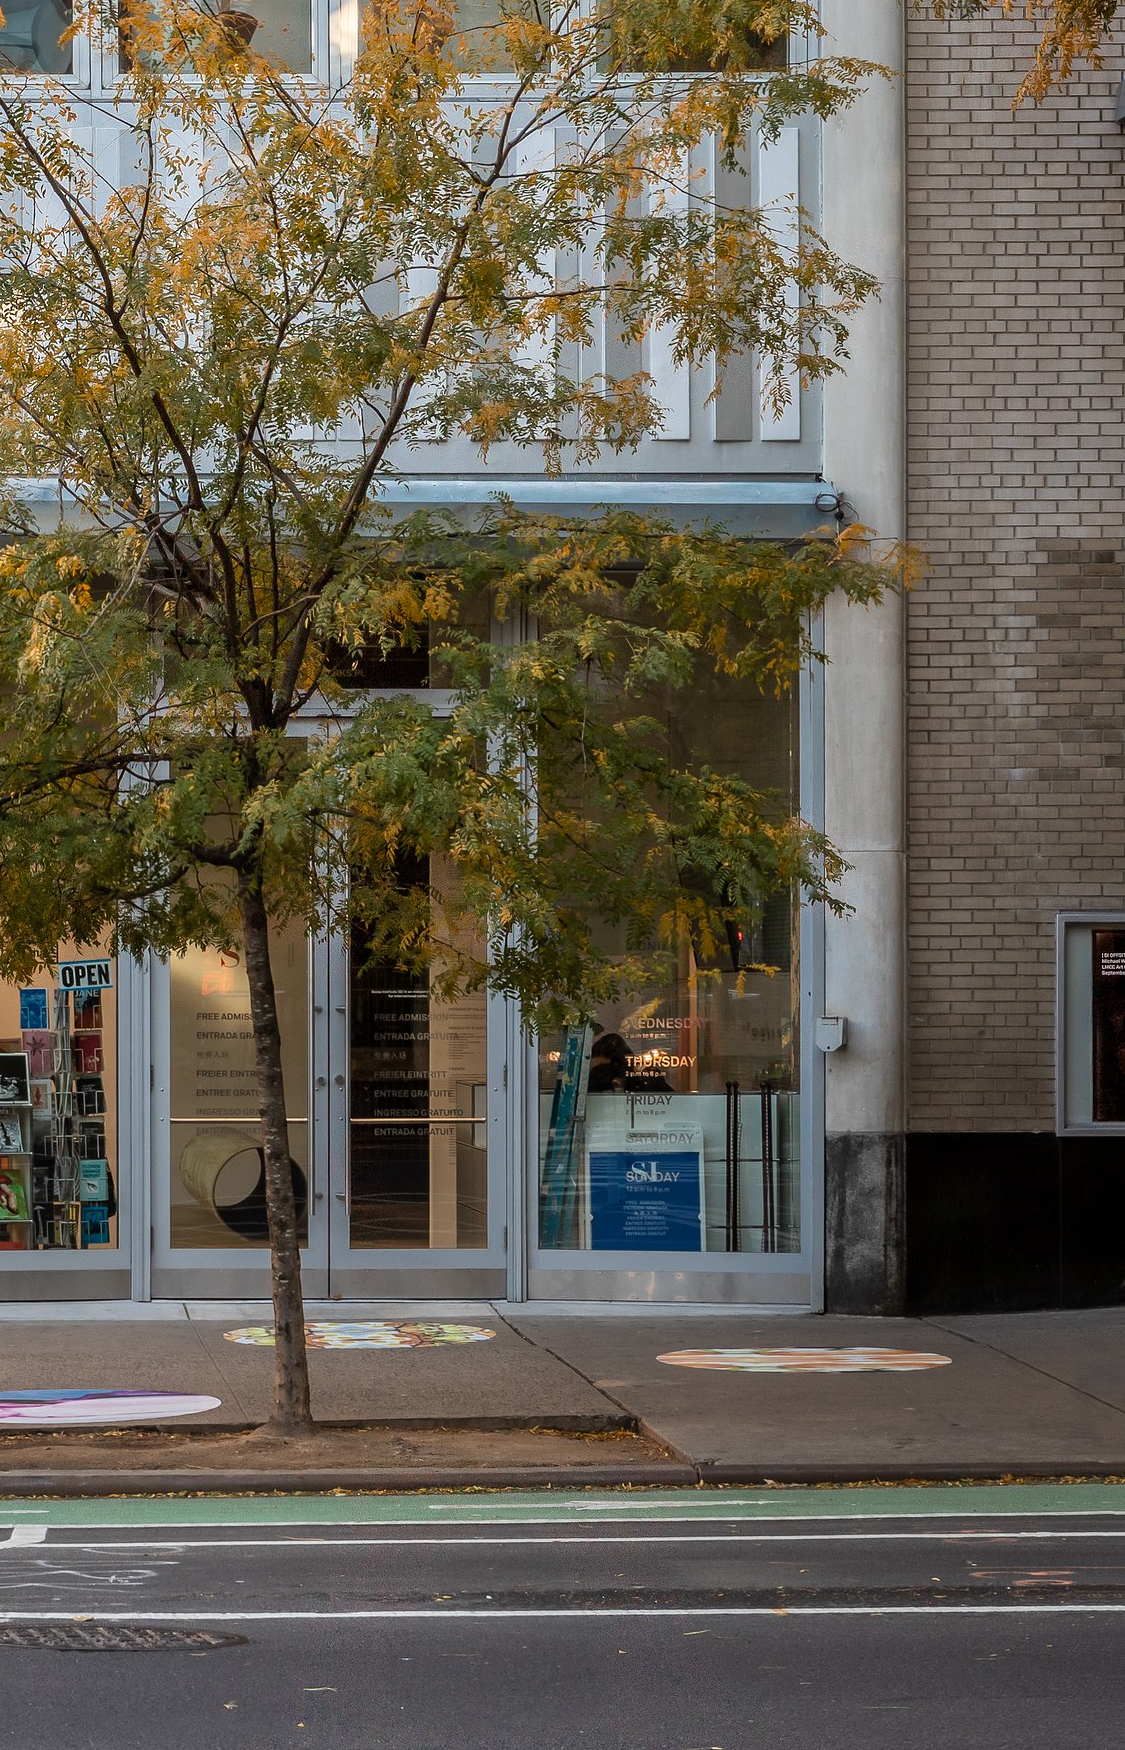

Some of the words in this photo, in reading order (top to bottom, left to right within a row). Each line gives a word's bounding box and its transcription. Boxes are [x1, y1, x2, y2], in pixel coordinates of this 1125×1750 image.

[61, 963, 111, 988] OPEN
[196, 1012, 220, 1020] FREE
[220, 1012, 253, 1020] ADMISS
[374, 1013, 396, 1021] FREE
[398, 1013, 449, 1021] ADMISSION
[625, 1017, 707, 1029] EDNESDAY
[196, 1031, 238, 1039] ENTRADA
[374, 1032, 416, 1040] ENTRADA
[416, 1032, 460, 1040] GRATUITA
[625, 1055, 697, 1067] THURSDAY
[196, 1070, 228, 1078] FREIER
[374, 1070, 406, 1079] FREIER
[407, 1070, 448, 1079] EINTRITT
[196, 1089, 231, 1097] ENTREE
[374, 1089, 409, 1098] ENTREE
[410, 1089, 455, 1098] GRATUITE
[626, 1095, 673, 1105] FRIDAY
[196, 1108, 241, 1116] INGRESSO
[374, 1108, 419, 1117] INGRESSO
[420, 1108, 464, 1117] GRATUITO
[374, 1127, 416, 1136] ENTRADA
[417, 1127, 455, 1136] GRATUIT
[625, 1132, 694, 1144] SATURDAY
[626, 1171, 680, 1182] SUNDAY
